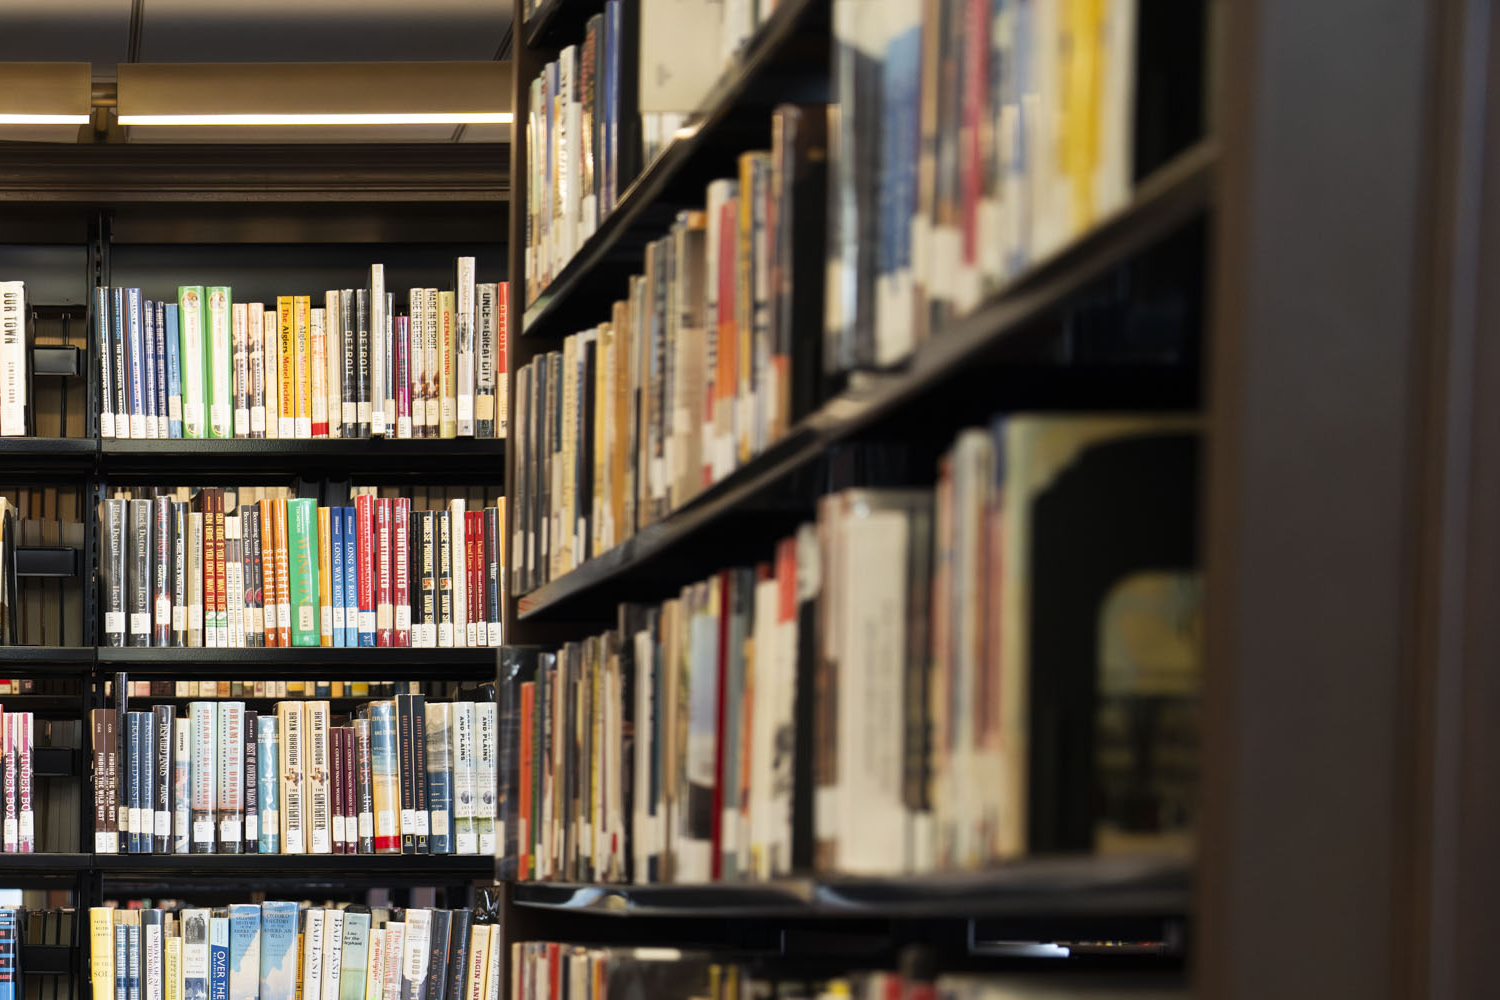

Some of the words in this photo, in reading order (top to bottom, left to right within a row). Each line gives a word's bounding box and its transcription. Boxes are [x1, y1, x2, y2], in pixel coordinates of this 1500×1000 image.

[3, 292, 17, 312] OUR
[427, 290, 437, 310] MADE
[281, 309, 290, 323] The
[3, 317, 17, 344] TOWN
[281, 325, 290, 354] Algiers
[427, 320, 437, 350] DETROIT
[345, 331, 353, 376] DETROIT
[360, 331, 368, 376] DETROIT
[482, 330, 491, 359] GREAT
[281, 356, 290, 379] Motel
[482, 361, 491, 383] CITY
[281, 381, 290, 415] Incident
[138, 505, 146, 528] Black
[205, 512, 213, 524] RUN
[111, 528, 119, 556] Detroit
[138, 529, 146, 557] Detroit
[205, 525, 213, 541] HOME
[205, 549, 213, 560] YOU
[333, 542, 341, 564] LONG
[347, 542, 355, 564] LONG
[397, 528, 406, 589] UNINTIMIDATED
[205, 561, 213, 576] DON'T
[263, 549, 274, 605] SEPARATE
[277, 549, 288, 605] SEPARATE
[334, 566, 342, 584] WAY
[112, 585, 120, 605] Herb
[138, 586, 146, 607] Herb
[205, 578, 213, 593] WANT
[206, 603, 214, 611] BE
[289, 711, 297, 730] BRYAN
[289, 733, 297, 765] BURROUGH
[5, 752, 15, 793] TINDER
[5, 795, 15, 820] BOX
[313, 918, 321, 942] BAD
[333, 918, 343, 942] BAD
[216, 951, 225, 978] OVER
[311, 946, 321, 979] LAND
[331, 946, 341, 979] LAND
[474, 949, 482, 978] VIRGIN
[216, 980, 225, 1000] THE
